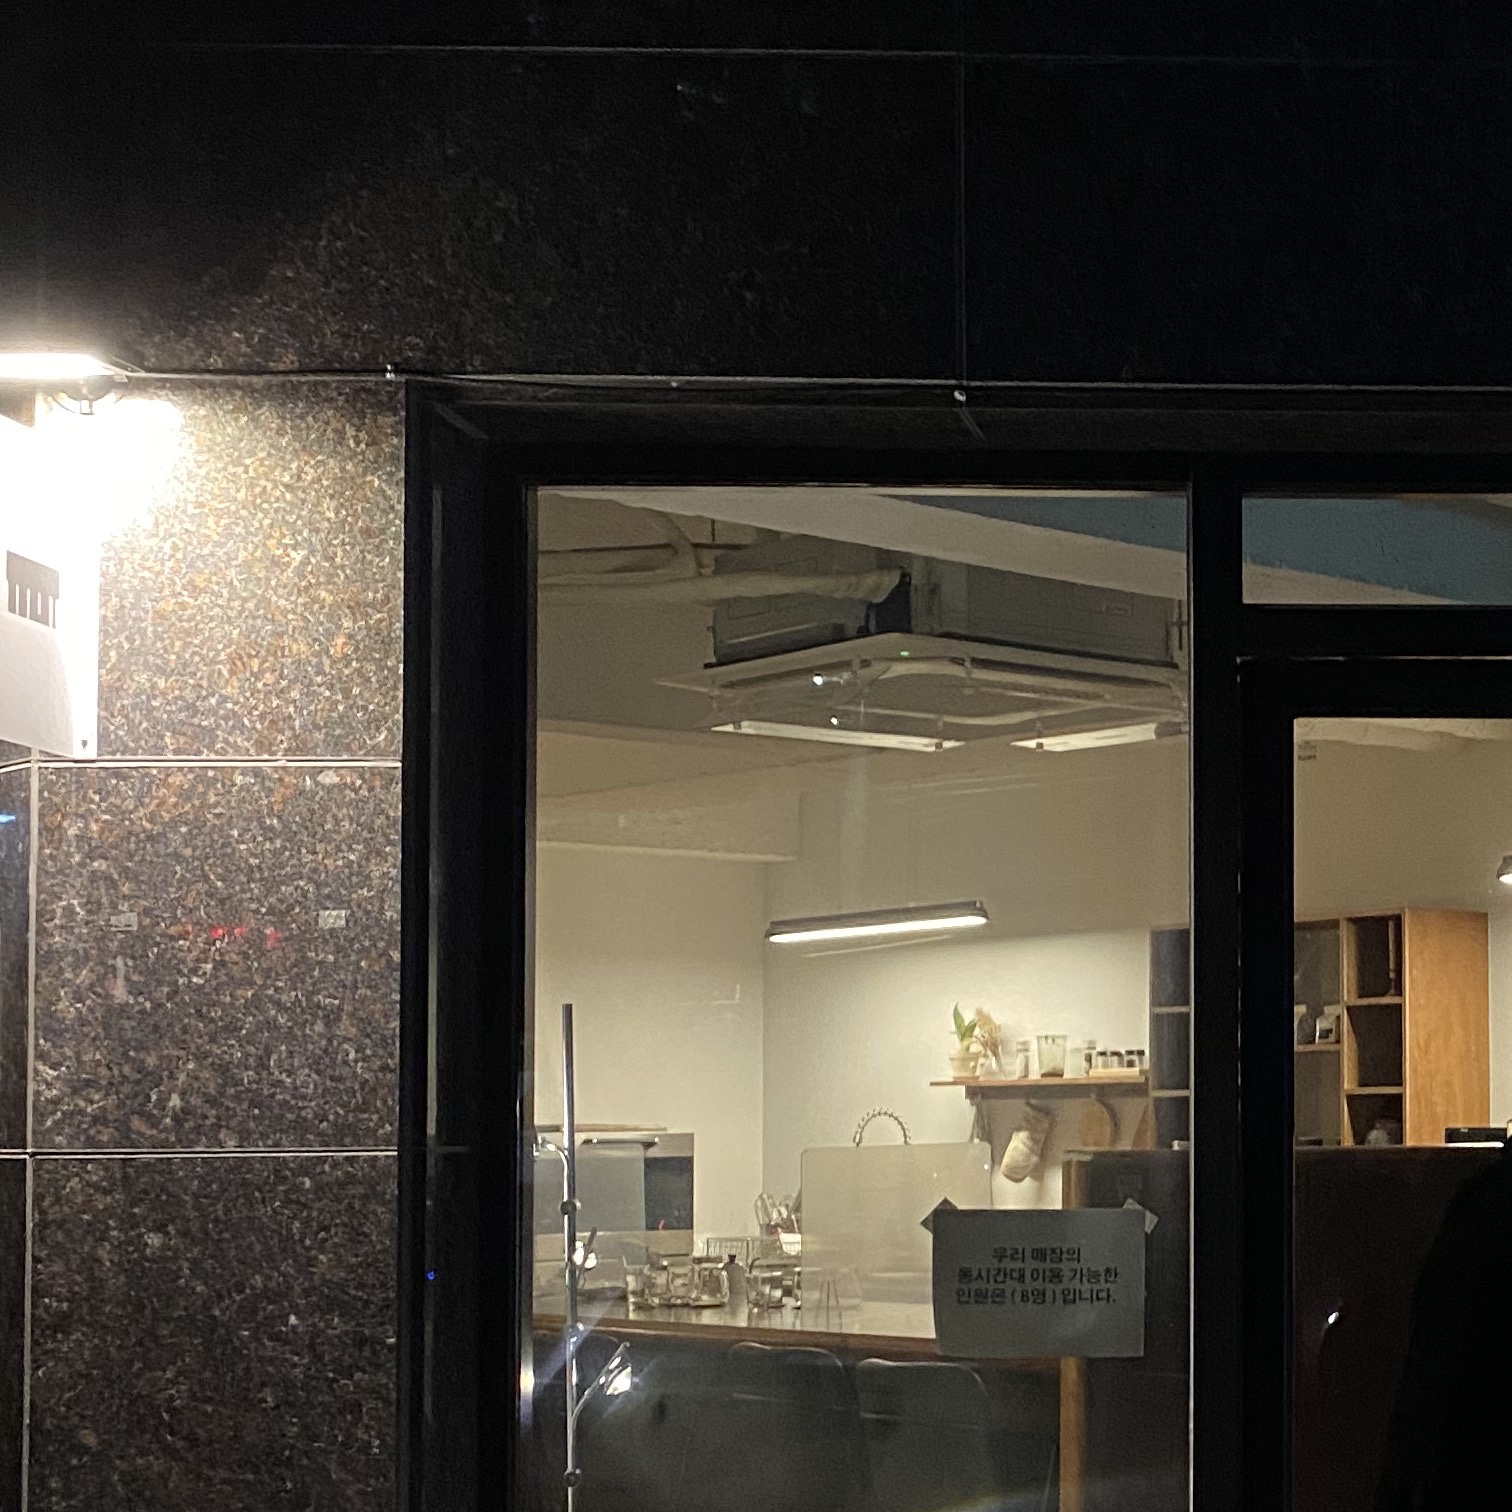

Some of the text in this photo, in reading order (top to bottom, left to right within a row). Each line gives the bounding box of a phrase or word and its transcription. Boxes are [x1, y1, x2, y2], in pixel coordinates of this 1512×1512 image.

[992, 1246, 1081, 1264] 우리 매장의
[957, 1266, 1119, 1284] 동시간대 이용 가능한
[956, 1287, 1006, 1305] 인원은
[1061, 1287, 1116, 1305] 입니다.
